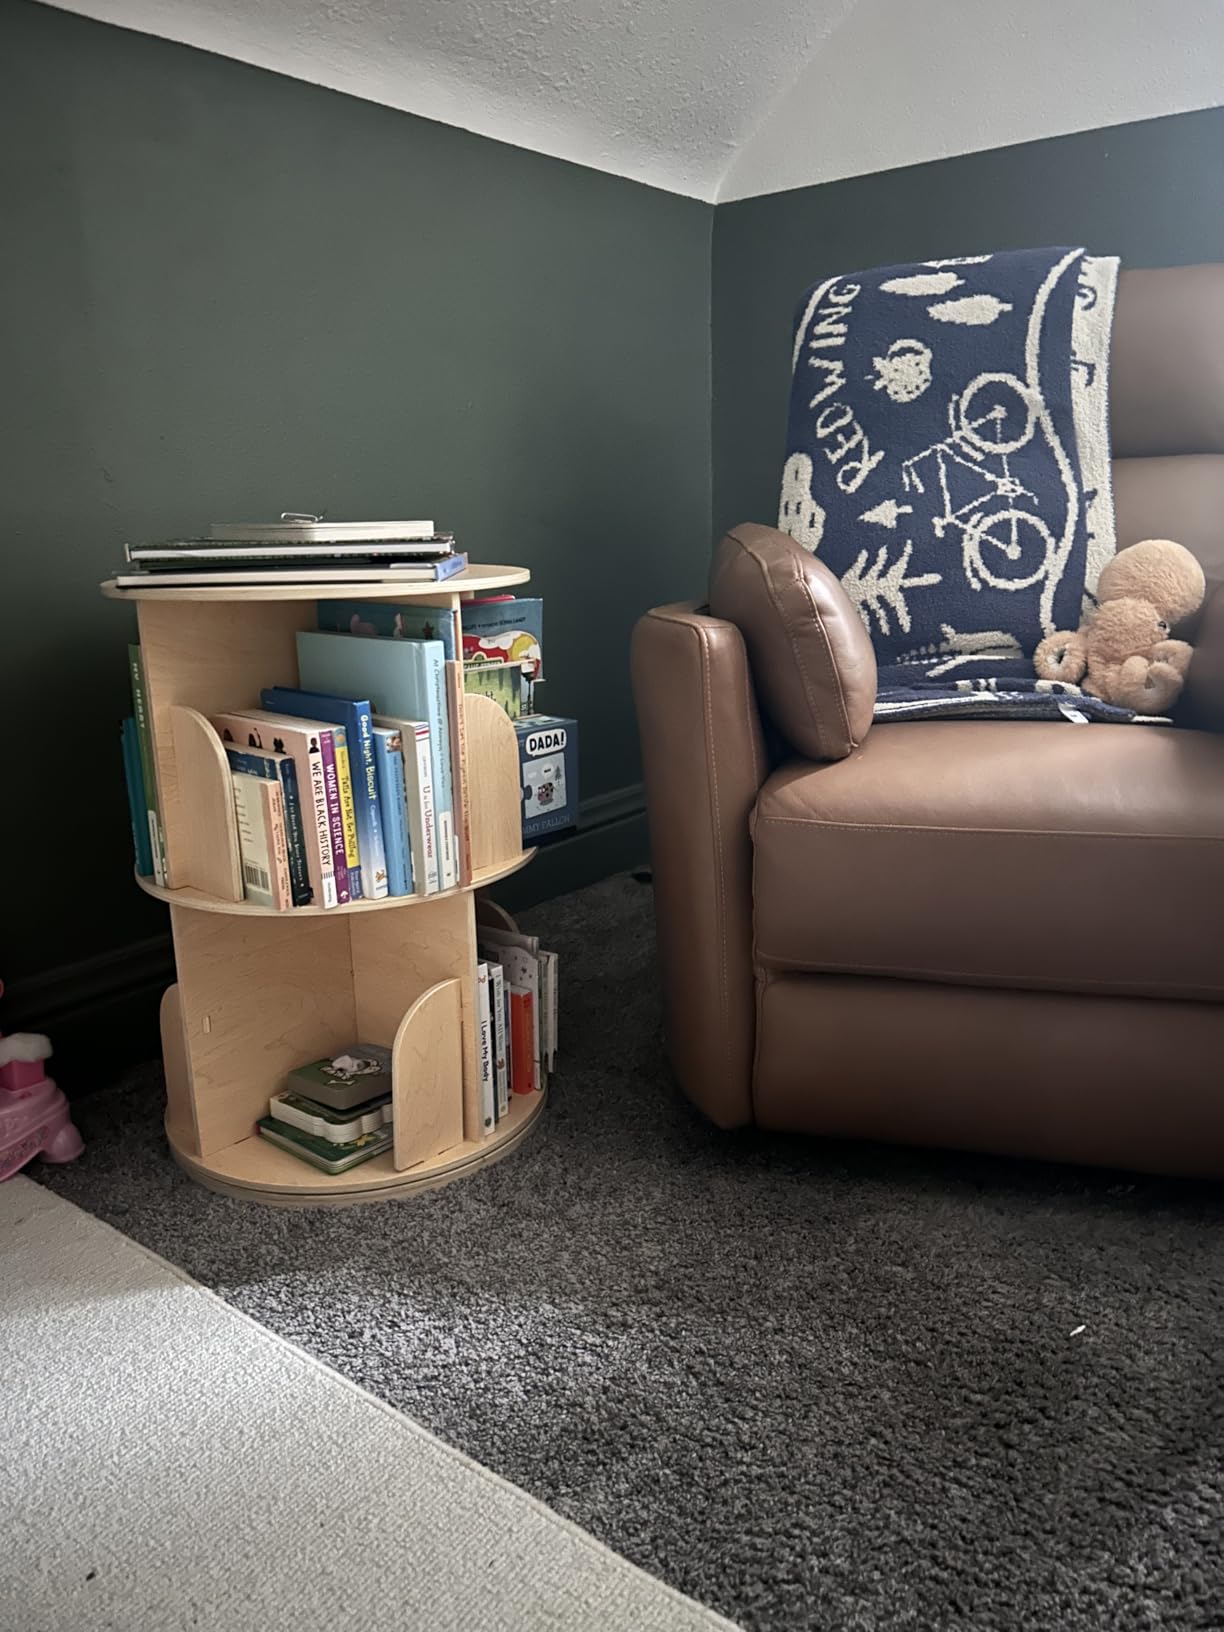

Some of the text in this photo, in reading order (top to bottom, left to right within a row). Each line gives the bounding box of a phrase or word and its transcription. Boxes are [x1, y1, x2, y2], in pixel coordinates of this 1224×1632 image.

[361, 715, 370, 738] Good
[530, 731, 564, 752] DADA!
[326, 763, 338, 800] WOMEN
[365, 765, 376, 800] Biscuit
[312, 761, 332, 866] WE ARE BLACK HISTORY
[330, 802, 340, 814] IN
[332, 816, 344, 856] SCIENCE
[424, 809, 434, 859] Underwear
[481, 1025, 489, 1046] Love
[481, 1046, 489, 1060] My
[482, 1061, 490, 1082] Body
